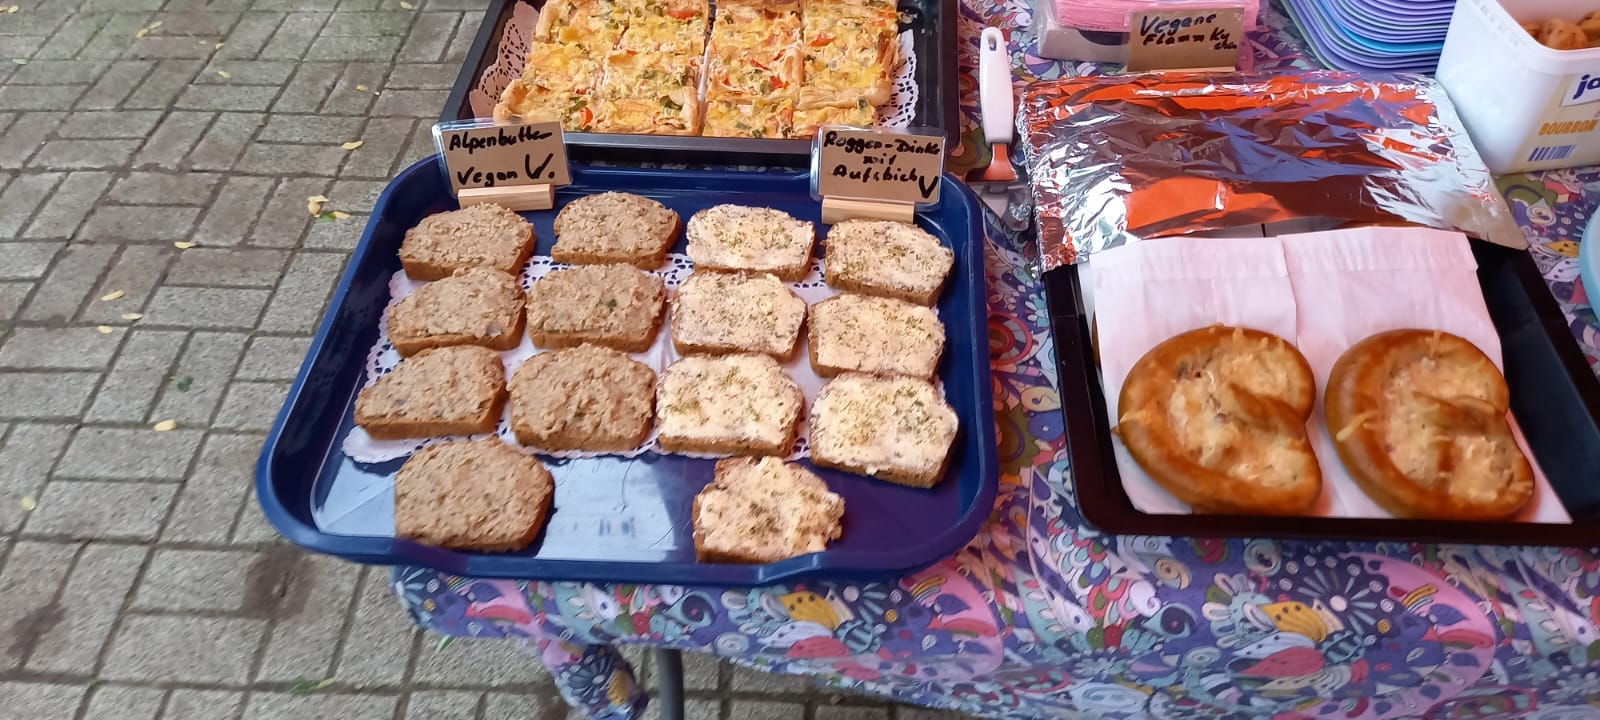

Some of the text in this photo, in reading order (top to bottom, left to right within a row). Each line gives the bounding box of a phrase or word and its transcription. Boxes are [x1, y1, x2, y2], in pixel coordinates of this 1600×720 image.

[1140, 14, 1217, 36] Vegane
[1143, 33, 1206, 45] Flamm
[1538, 119, 1599, 136] BOURBON
[863, 153, 897, 165] mit
[457, 167, 518, 187] Vegan
